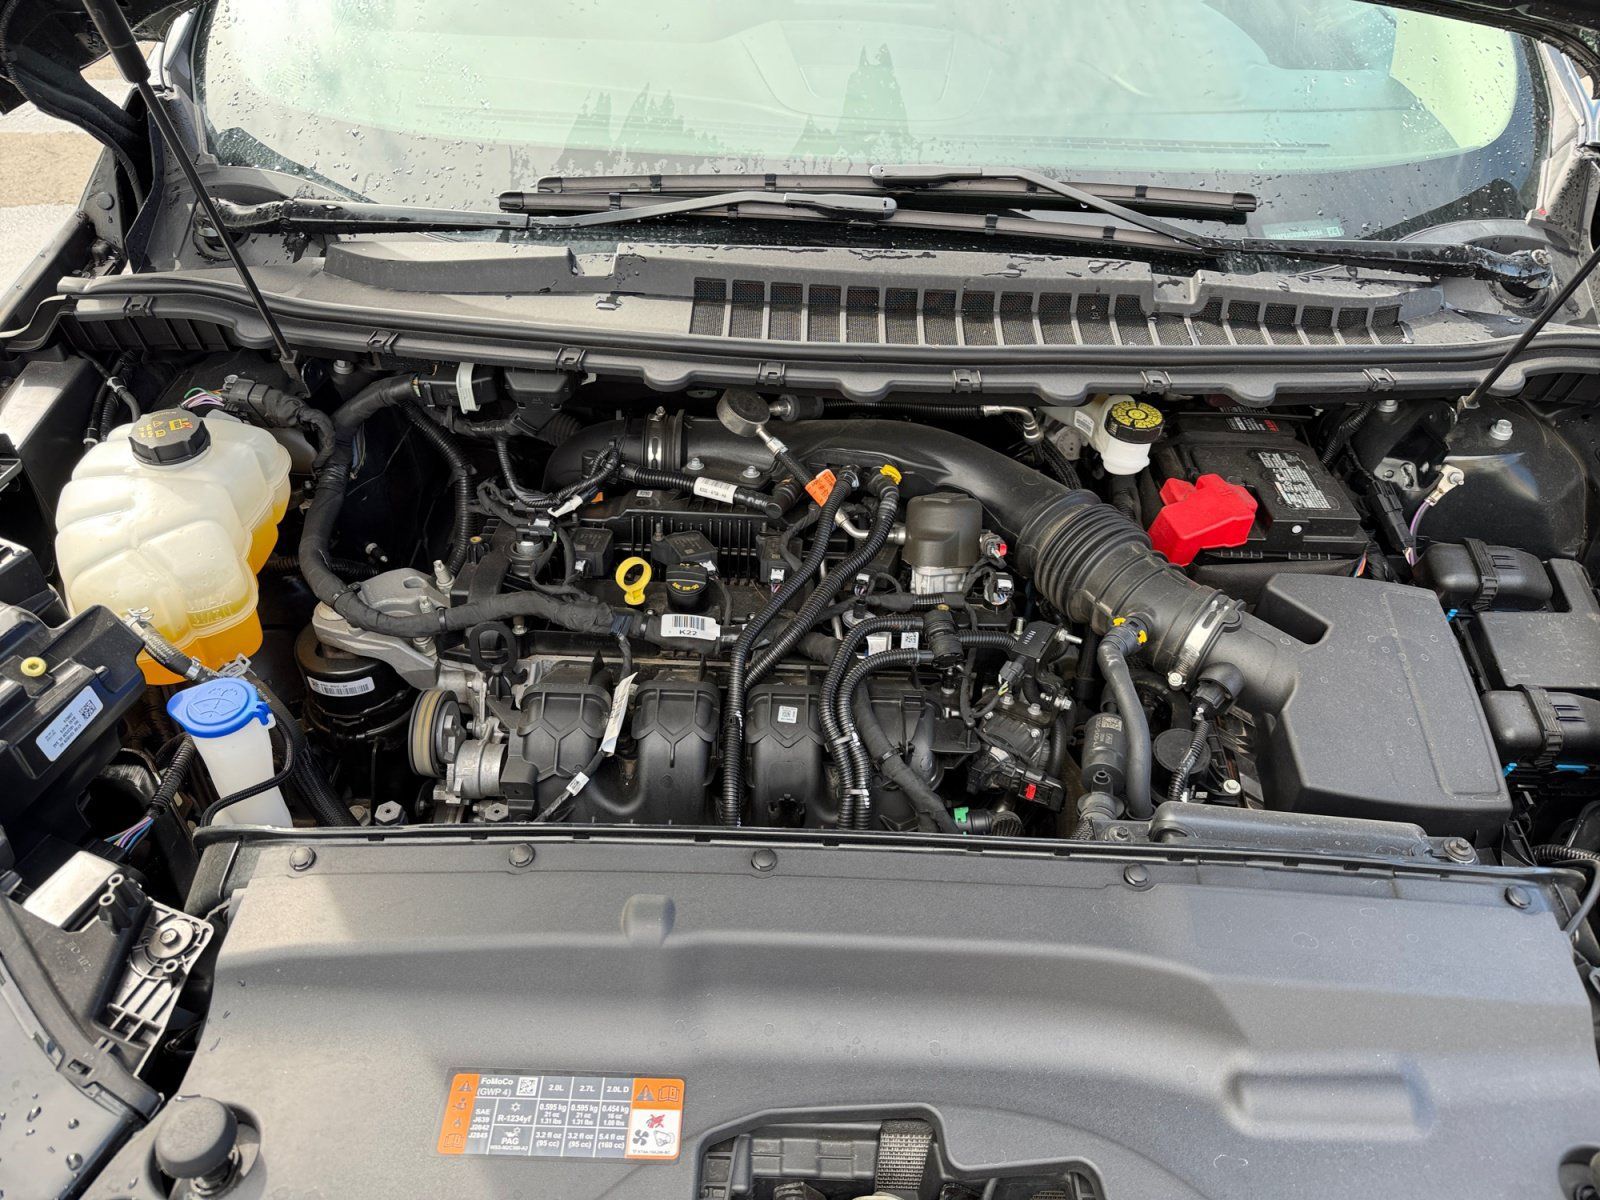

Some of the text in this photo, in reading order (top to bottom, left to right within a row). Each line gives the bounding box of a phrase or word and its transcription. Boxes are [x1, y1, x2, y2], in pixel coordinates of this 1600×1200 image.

[480, 1077, 514, 1085] FoMoCo
[476, 1087, 512, 1097] (GWP 4)
[539, 1103, 567, 1113] 0.595 kg
[589, 1104, 598, 1113] kg
[602, 1104, 630, 1114] 0.454 kg
[496, 1114, 532, 1124] R-1234yf
[535, 1131, 547, 1139] 3.2
[501, 1137, 519, 1145] PAG
[536, 1139, 560, 1149] (95 cc)
[568, 1140, 592, 1149] (95 cc)
[613, 1141, 625, 1151] cc)
